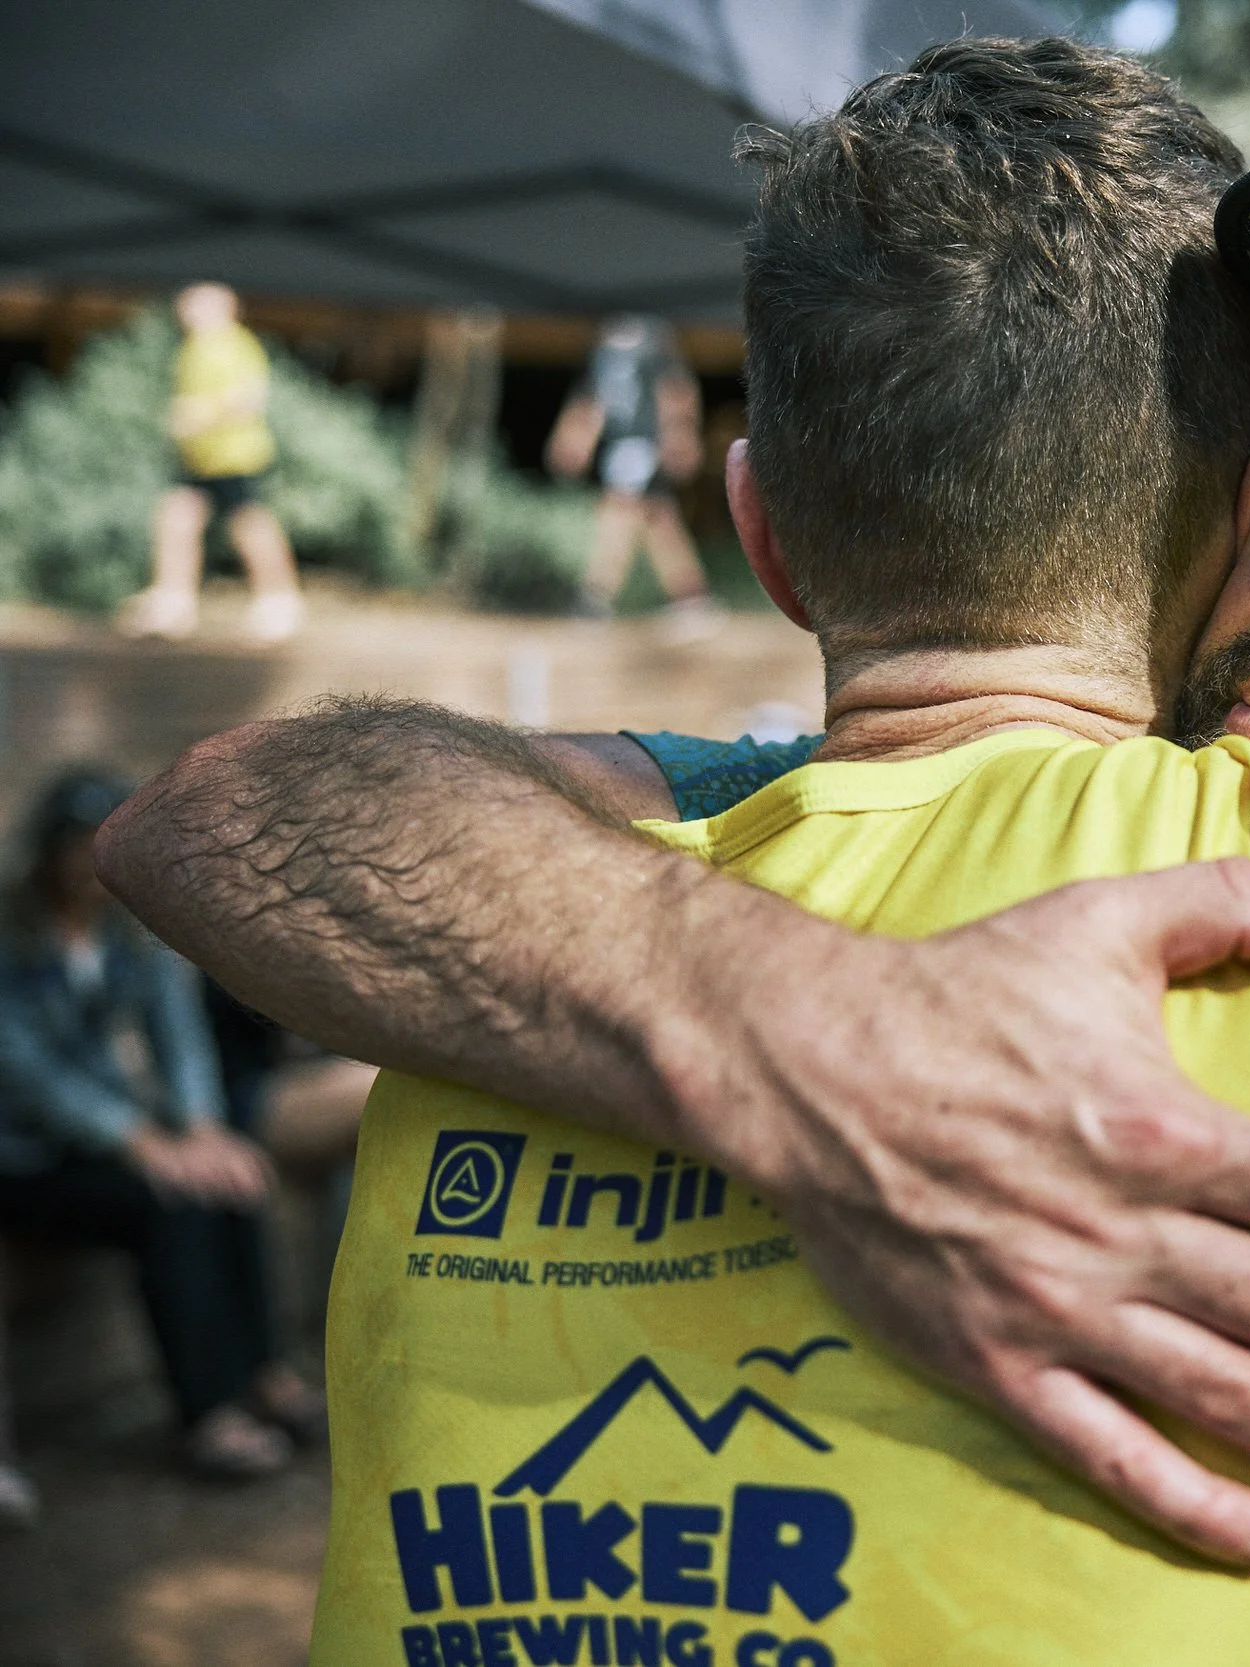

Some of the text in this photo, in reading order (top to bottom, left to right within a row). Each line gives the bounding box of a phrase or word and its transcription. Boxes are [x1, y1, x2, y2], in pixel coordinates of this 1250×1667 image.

[406, 1253, 434, 1277] THE
[436, 1256, 533, 1286] ORIGINAL
[541, 1252, 719, 1288] PERFORMANCE
[390, 1482, 855, 1624] HIKER
[401, 1614, 715, 1667] BREWING
